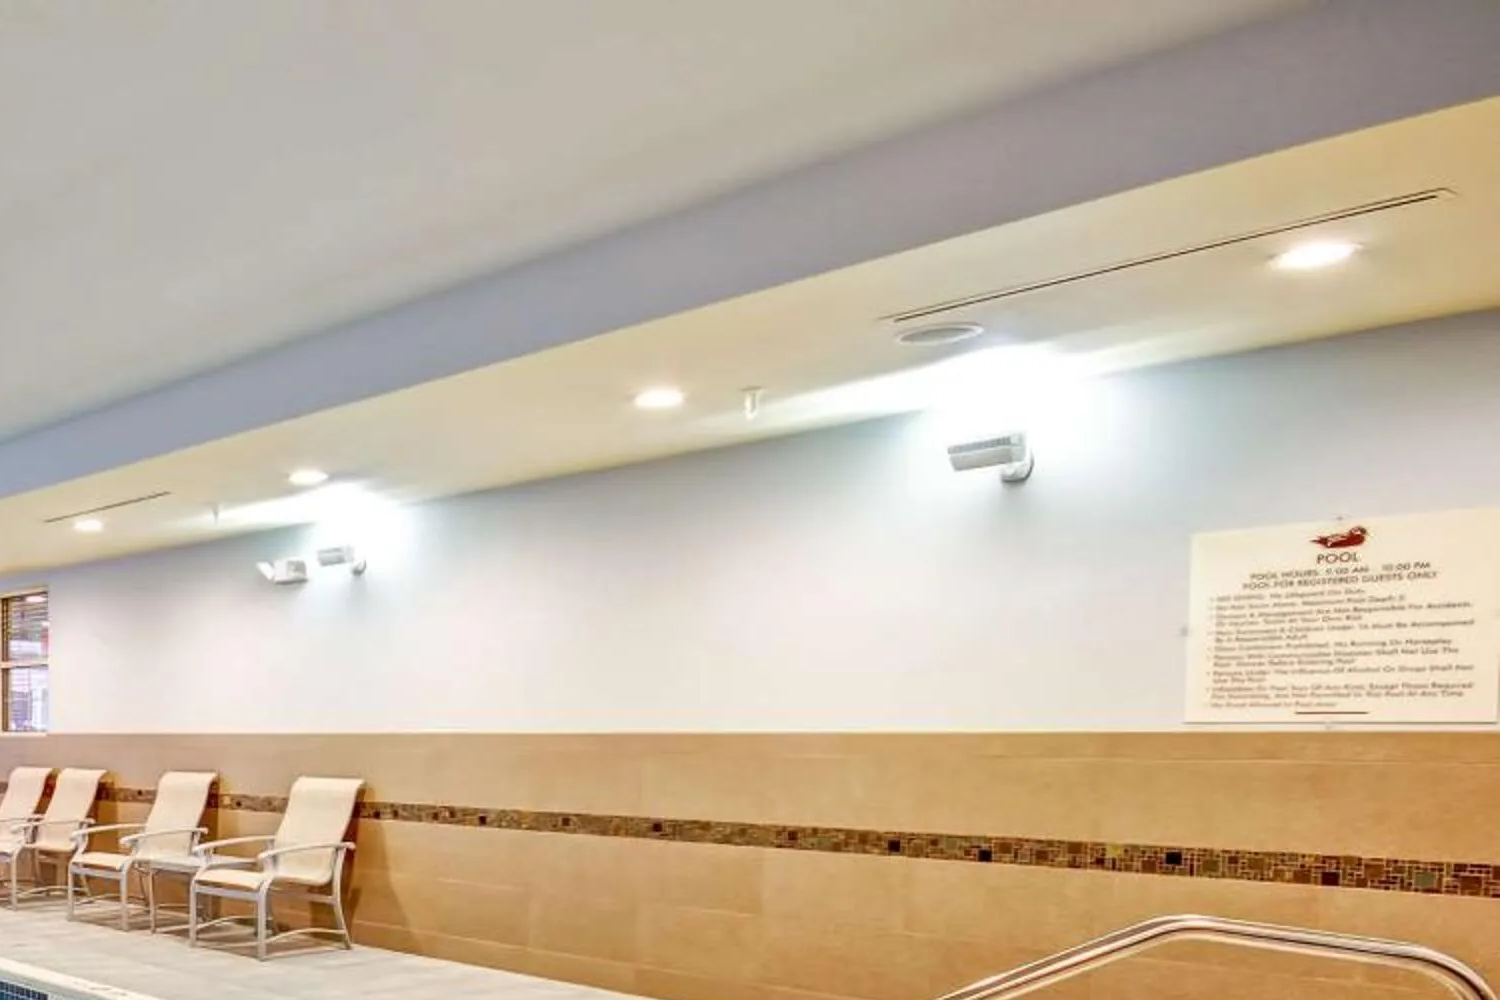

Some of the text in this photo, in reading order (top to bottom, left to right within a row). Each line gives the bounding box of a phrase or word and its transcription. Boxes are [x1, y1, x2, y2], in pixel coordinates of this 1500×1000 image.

[1316, 551, 1360, 564] POOL
[1250, 572, 1278, 581] POOL
[1413, 561, 1431, 569] PM
[1274, 580, 1294, 588] FOR
[1297, 576, 1358, 586] REGISTERED
[1362, 573, 1403, 583] GUESTS
[1407, 571, 1437, 581] ONLY
